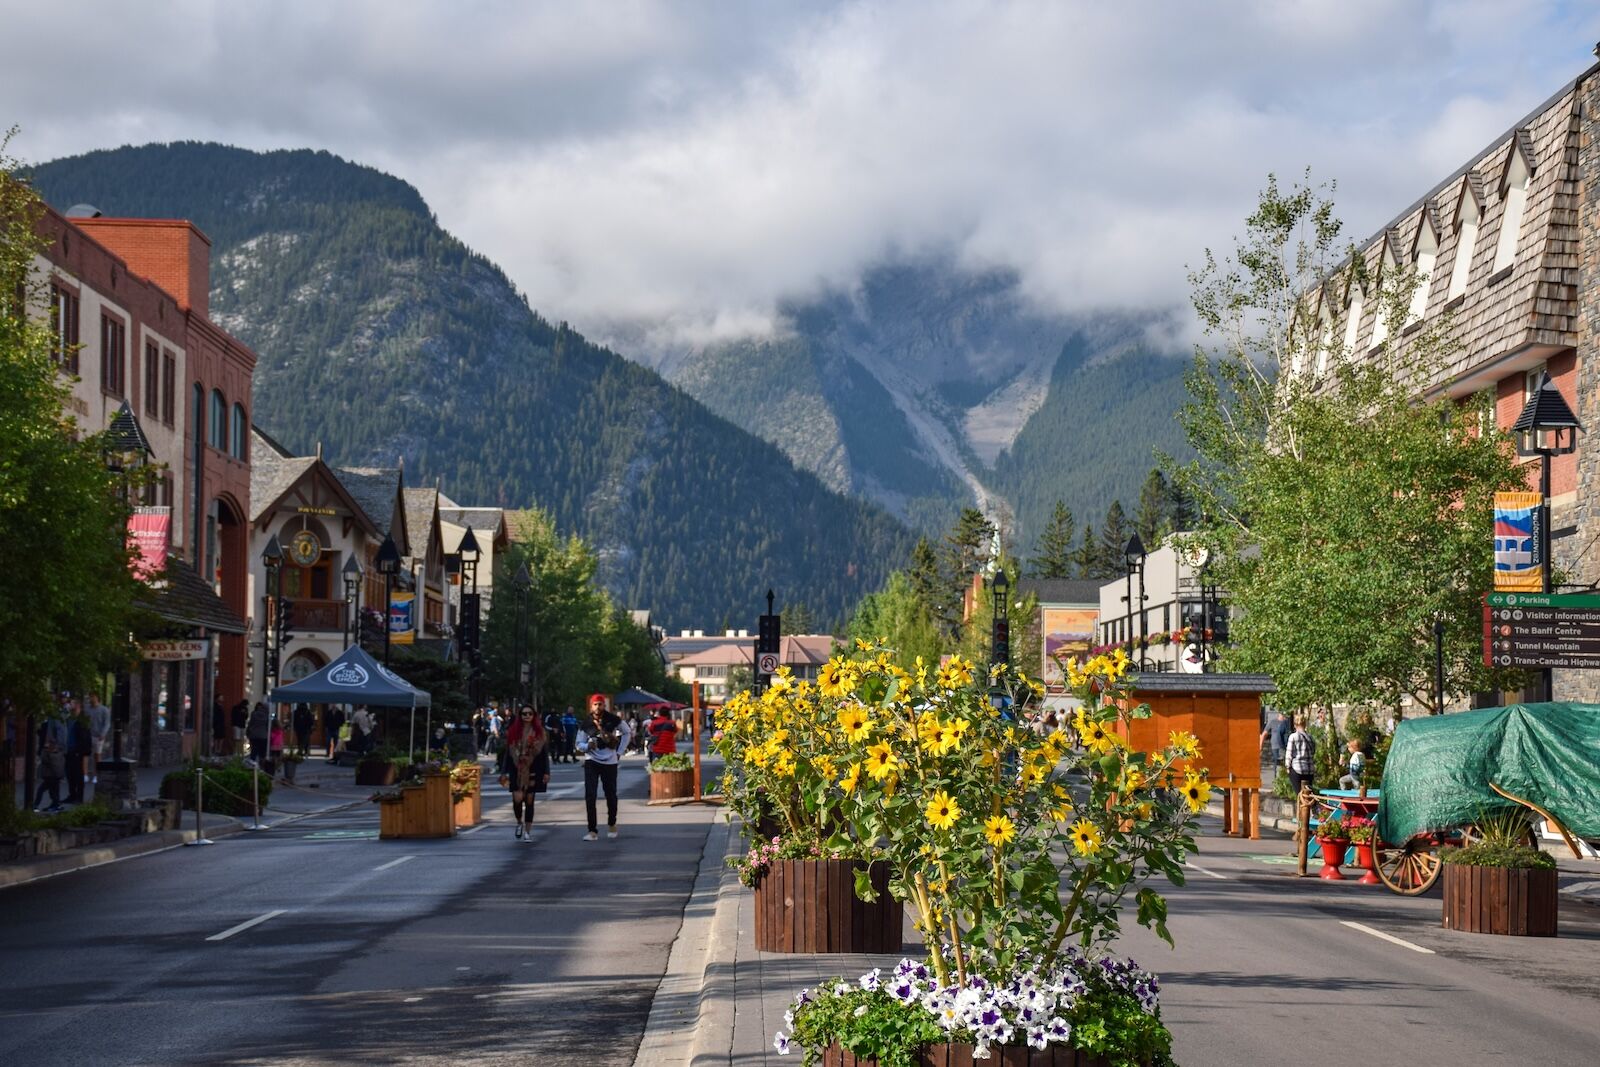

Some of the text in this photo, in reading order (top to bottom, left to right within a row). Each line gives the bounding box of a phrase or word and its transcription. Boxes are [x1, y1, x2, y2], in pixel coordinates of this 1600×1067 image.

[1519, 596, 1550, 605] Parking
[1526, 611, 1600, 620] Visitor Information
[1531, 627, 1553, 635] Banff
[1555, 627, 1582, 635] Centre
[180, 642, 202, 651] GEMS
[1514, 642, 1541, 650] Tunnel
[1514, 657, 1568, 665] Trans-Canada
